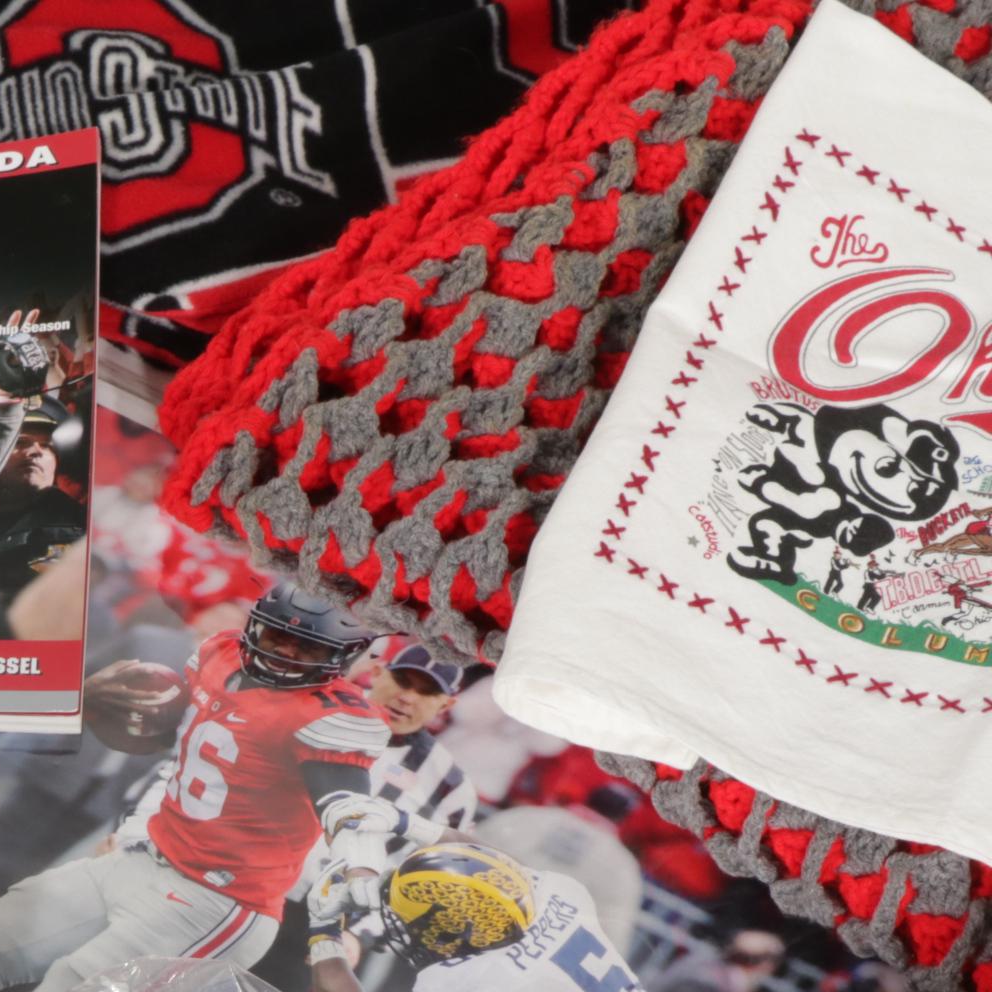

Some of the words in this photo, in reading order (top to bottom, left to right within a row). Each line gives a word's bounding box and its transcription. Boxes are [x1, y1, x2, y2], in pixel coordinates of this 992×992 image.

[809, 214, 889, 269] The
[21, 320, 71, 334] Season
[506, 893, 579, 972] PEPPERS
